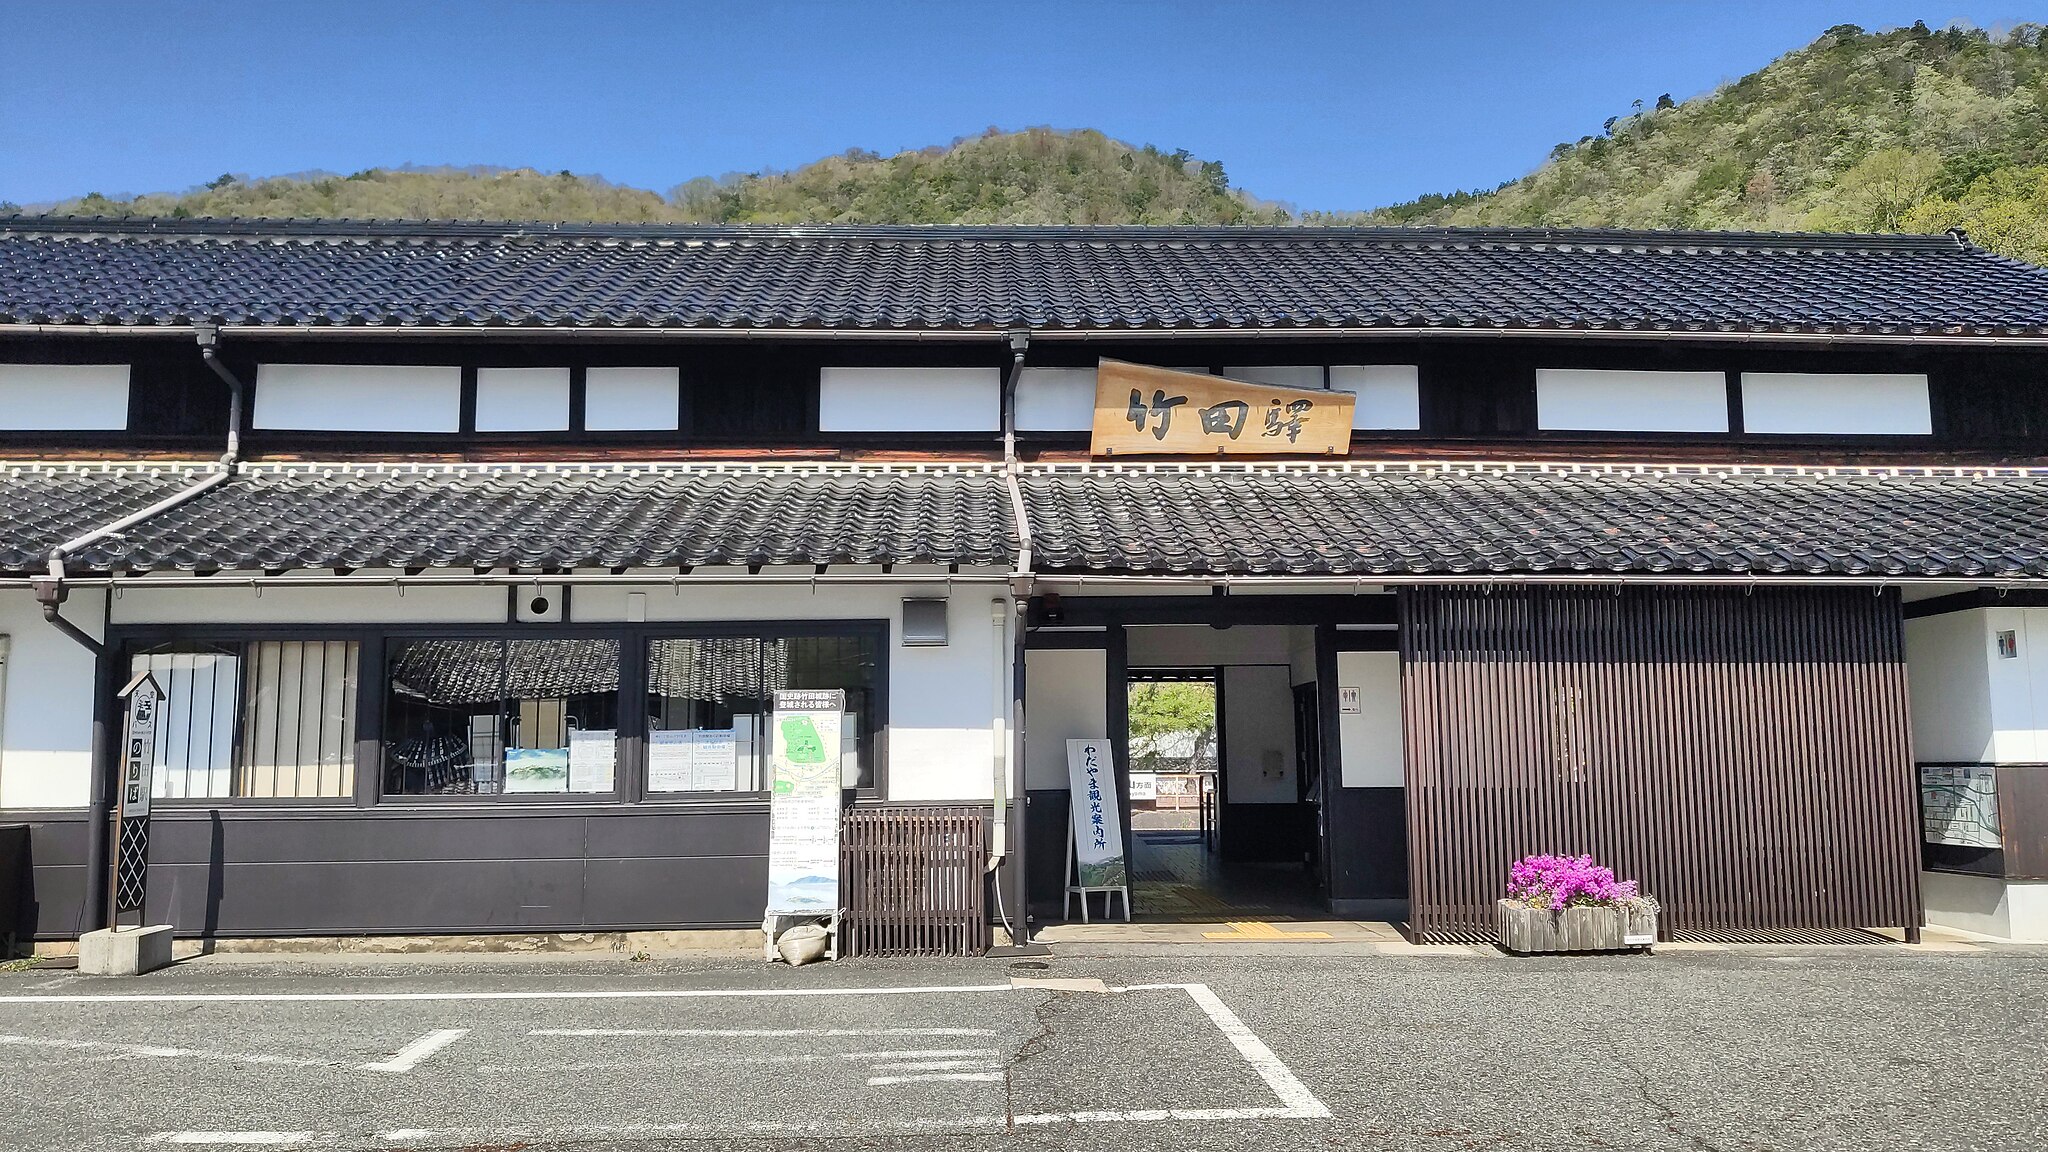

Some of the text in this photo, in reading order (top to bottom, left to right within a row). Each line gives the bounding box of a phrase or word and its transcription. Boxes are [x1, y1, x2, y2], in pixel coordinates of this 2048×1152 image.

[1126, 388, 1314, 444] 竹田驛
[779, 692, 837, 700] 国史跡竹田城跡に
[779, 701, 837, 709] 登城される皆様へ
[129, 741, 142, 801] のりば
[1084, 744, 1107, 851] わだやま観光案内所
